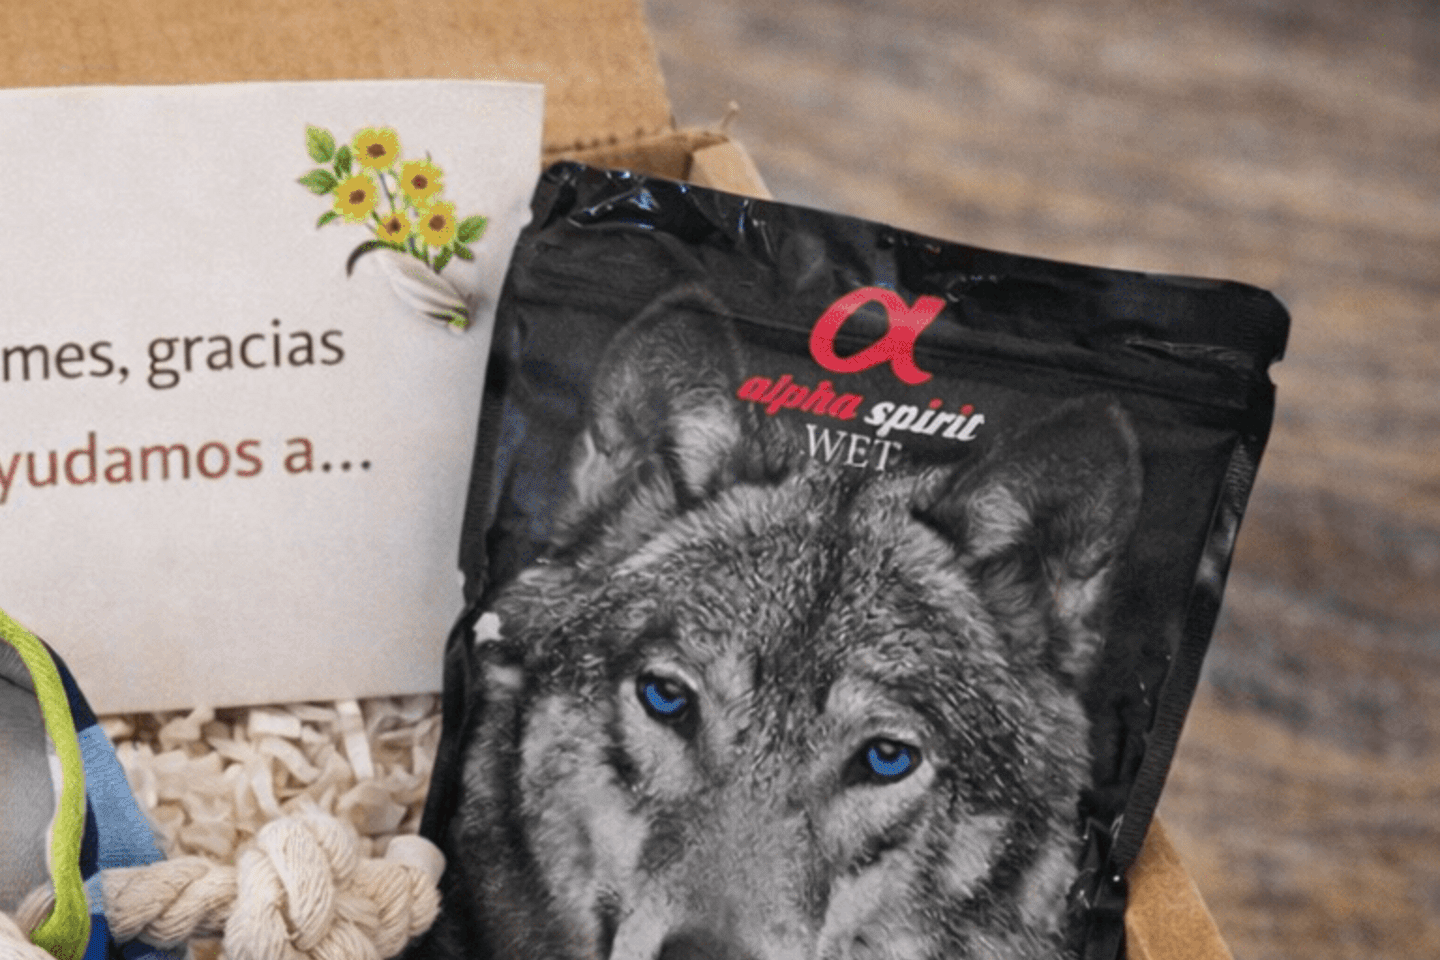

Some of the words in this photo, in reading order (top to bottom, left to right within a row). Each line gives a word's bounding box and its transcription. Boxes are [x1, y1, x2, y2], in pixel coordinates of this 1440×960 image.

[2, 337, 129, 384] mes,
[147, 318, 345, 389] gracias
[737, 374, 863, 420] alpha
[863, 398, 985, 441] spirit
[805, 424, 902, 471] WET
